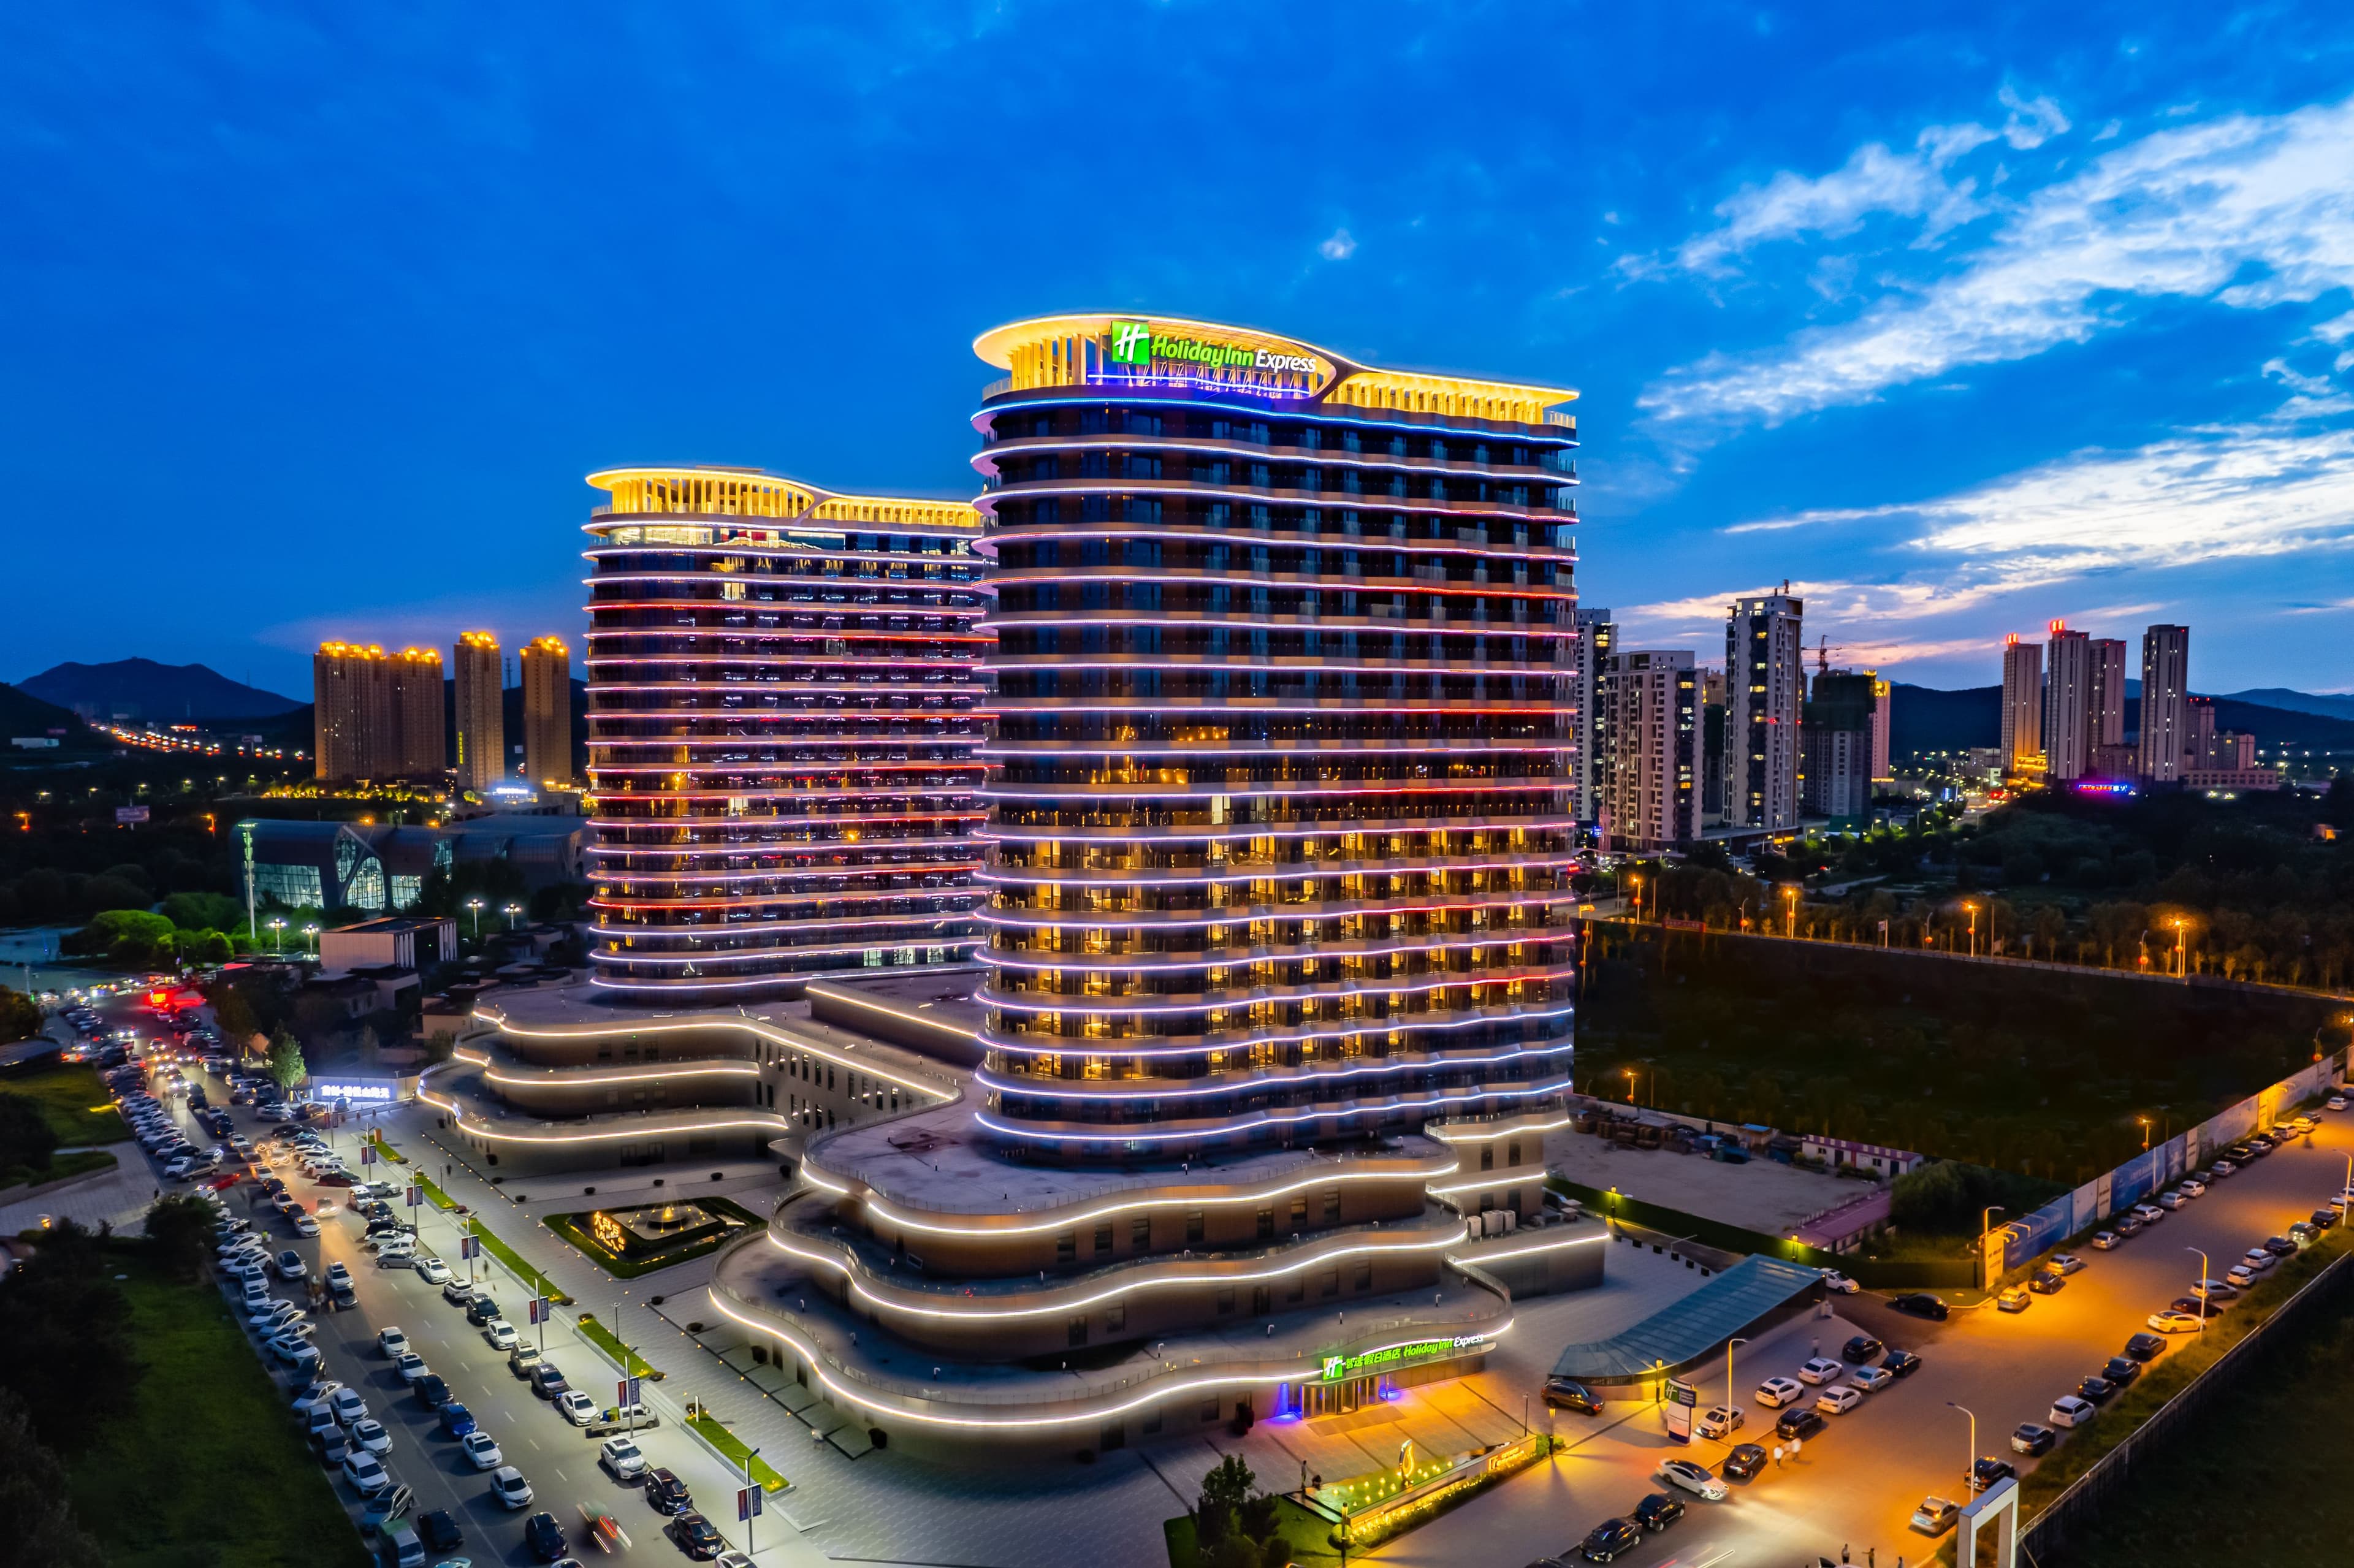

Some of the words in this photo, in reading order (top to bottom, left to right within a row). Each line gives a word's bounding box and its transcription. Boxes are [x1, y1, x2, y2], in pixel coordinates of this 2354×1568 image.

[1151, 334, 1224, 368] Holiday
[1225, 343, 1254, 367] Inn
[1255, 349, 1317, 373] Express
[1403, 1342, 1438, 1357] Holiday
[1453, 1334, 1484, 1347] Express
[1346, 1348, 1401, 1369] 智选假日酒店
